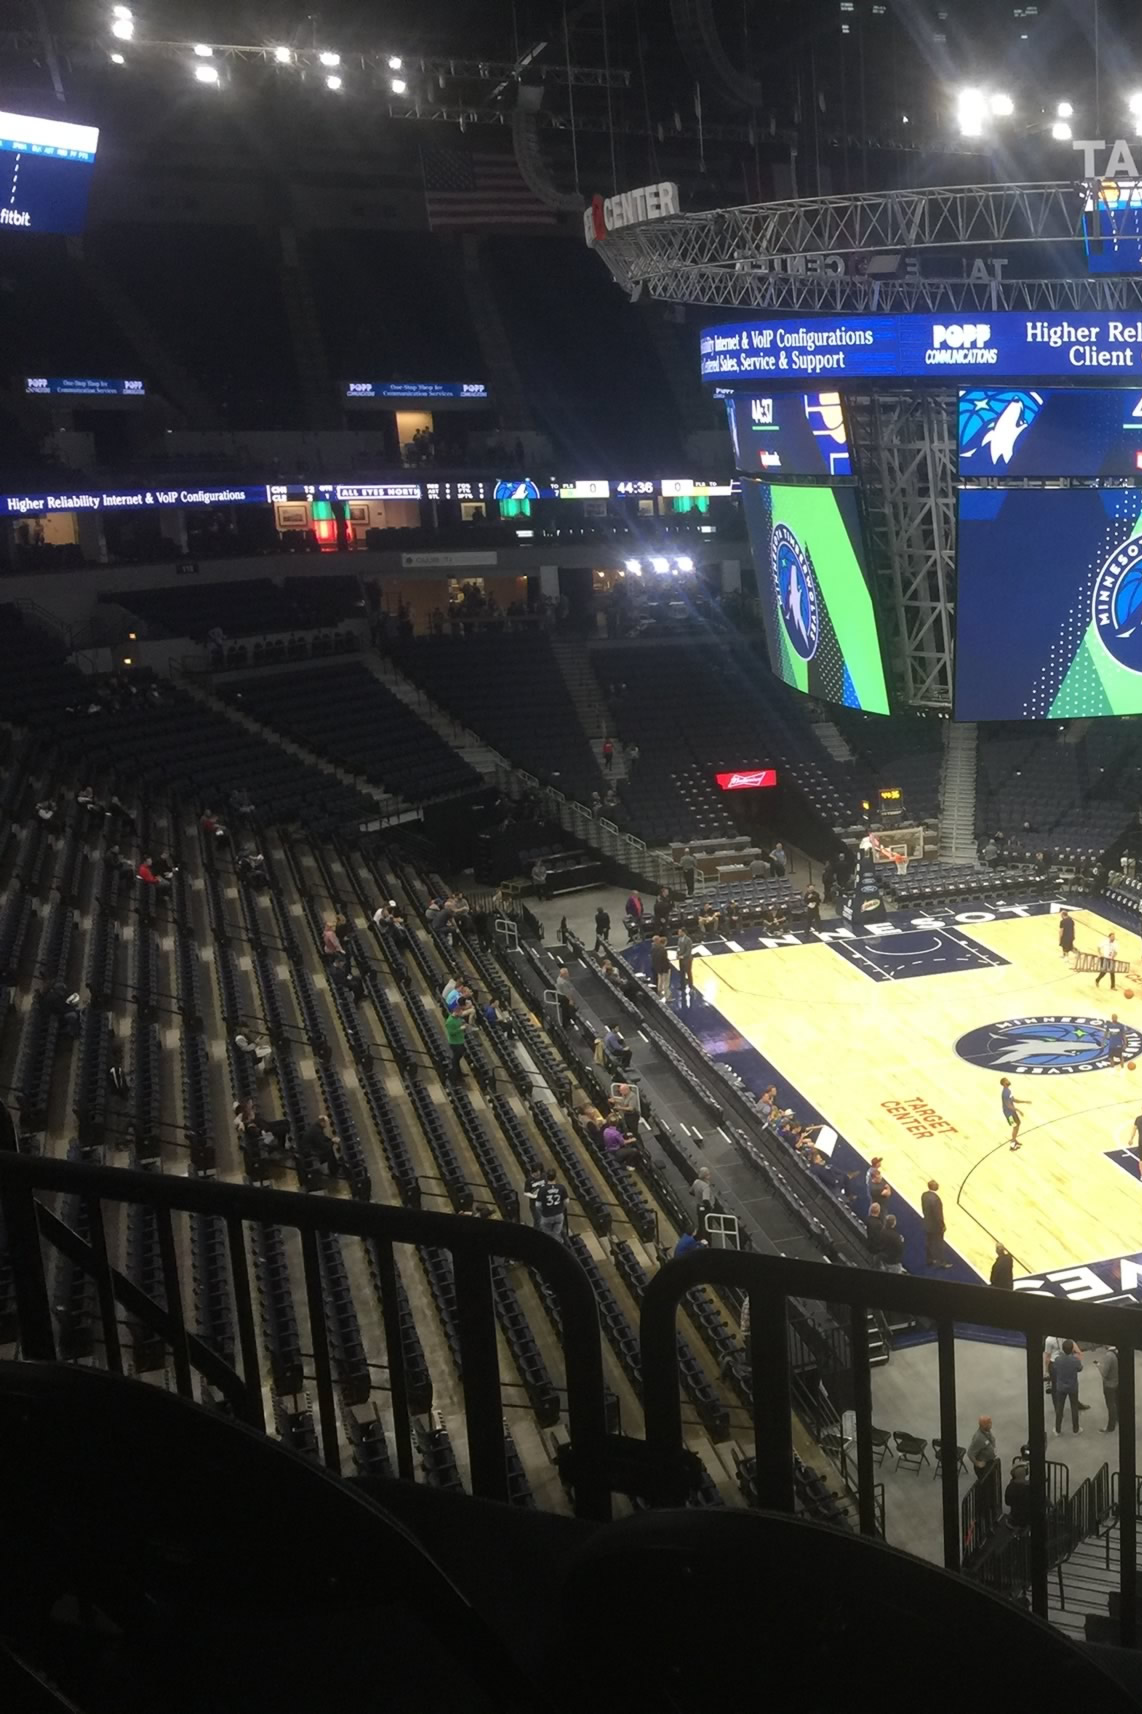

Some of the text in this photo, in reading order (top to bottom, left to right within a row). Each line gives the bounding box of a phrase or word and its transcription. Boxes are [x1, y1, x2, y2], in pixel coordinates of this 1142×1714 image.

[603, 181, 678, 231] CENTER
[741, 331, 749, 349] &
[751, 330, 774, 348] VoIP
[776, 325, 873, 351] Configurations
[932, 324, 991, 349] POPP
[1026, 322, 1100, 347] Higher
[740, 352, 776, 371] Service
[778, 350, 789, 369] &
[791, 350, 846, 373] Support
[925, 348, 998, 365] COMMUNICATIONS
[1069, 346, 1133, 367] Client
[617, 482, 653, 494] 44:36
[7, 490, 245, 512] Higher Reliability Internet & VoIP Configurations
[880, 1100, 934, 1140] CENTER
[904, 1096, 958, 1135] TARGET
[546, 1194, 561, 1206] 32
